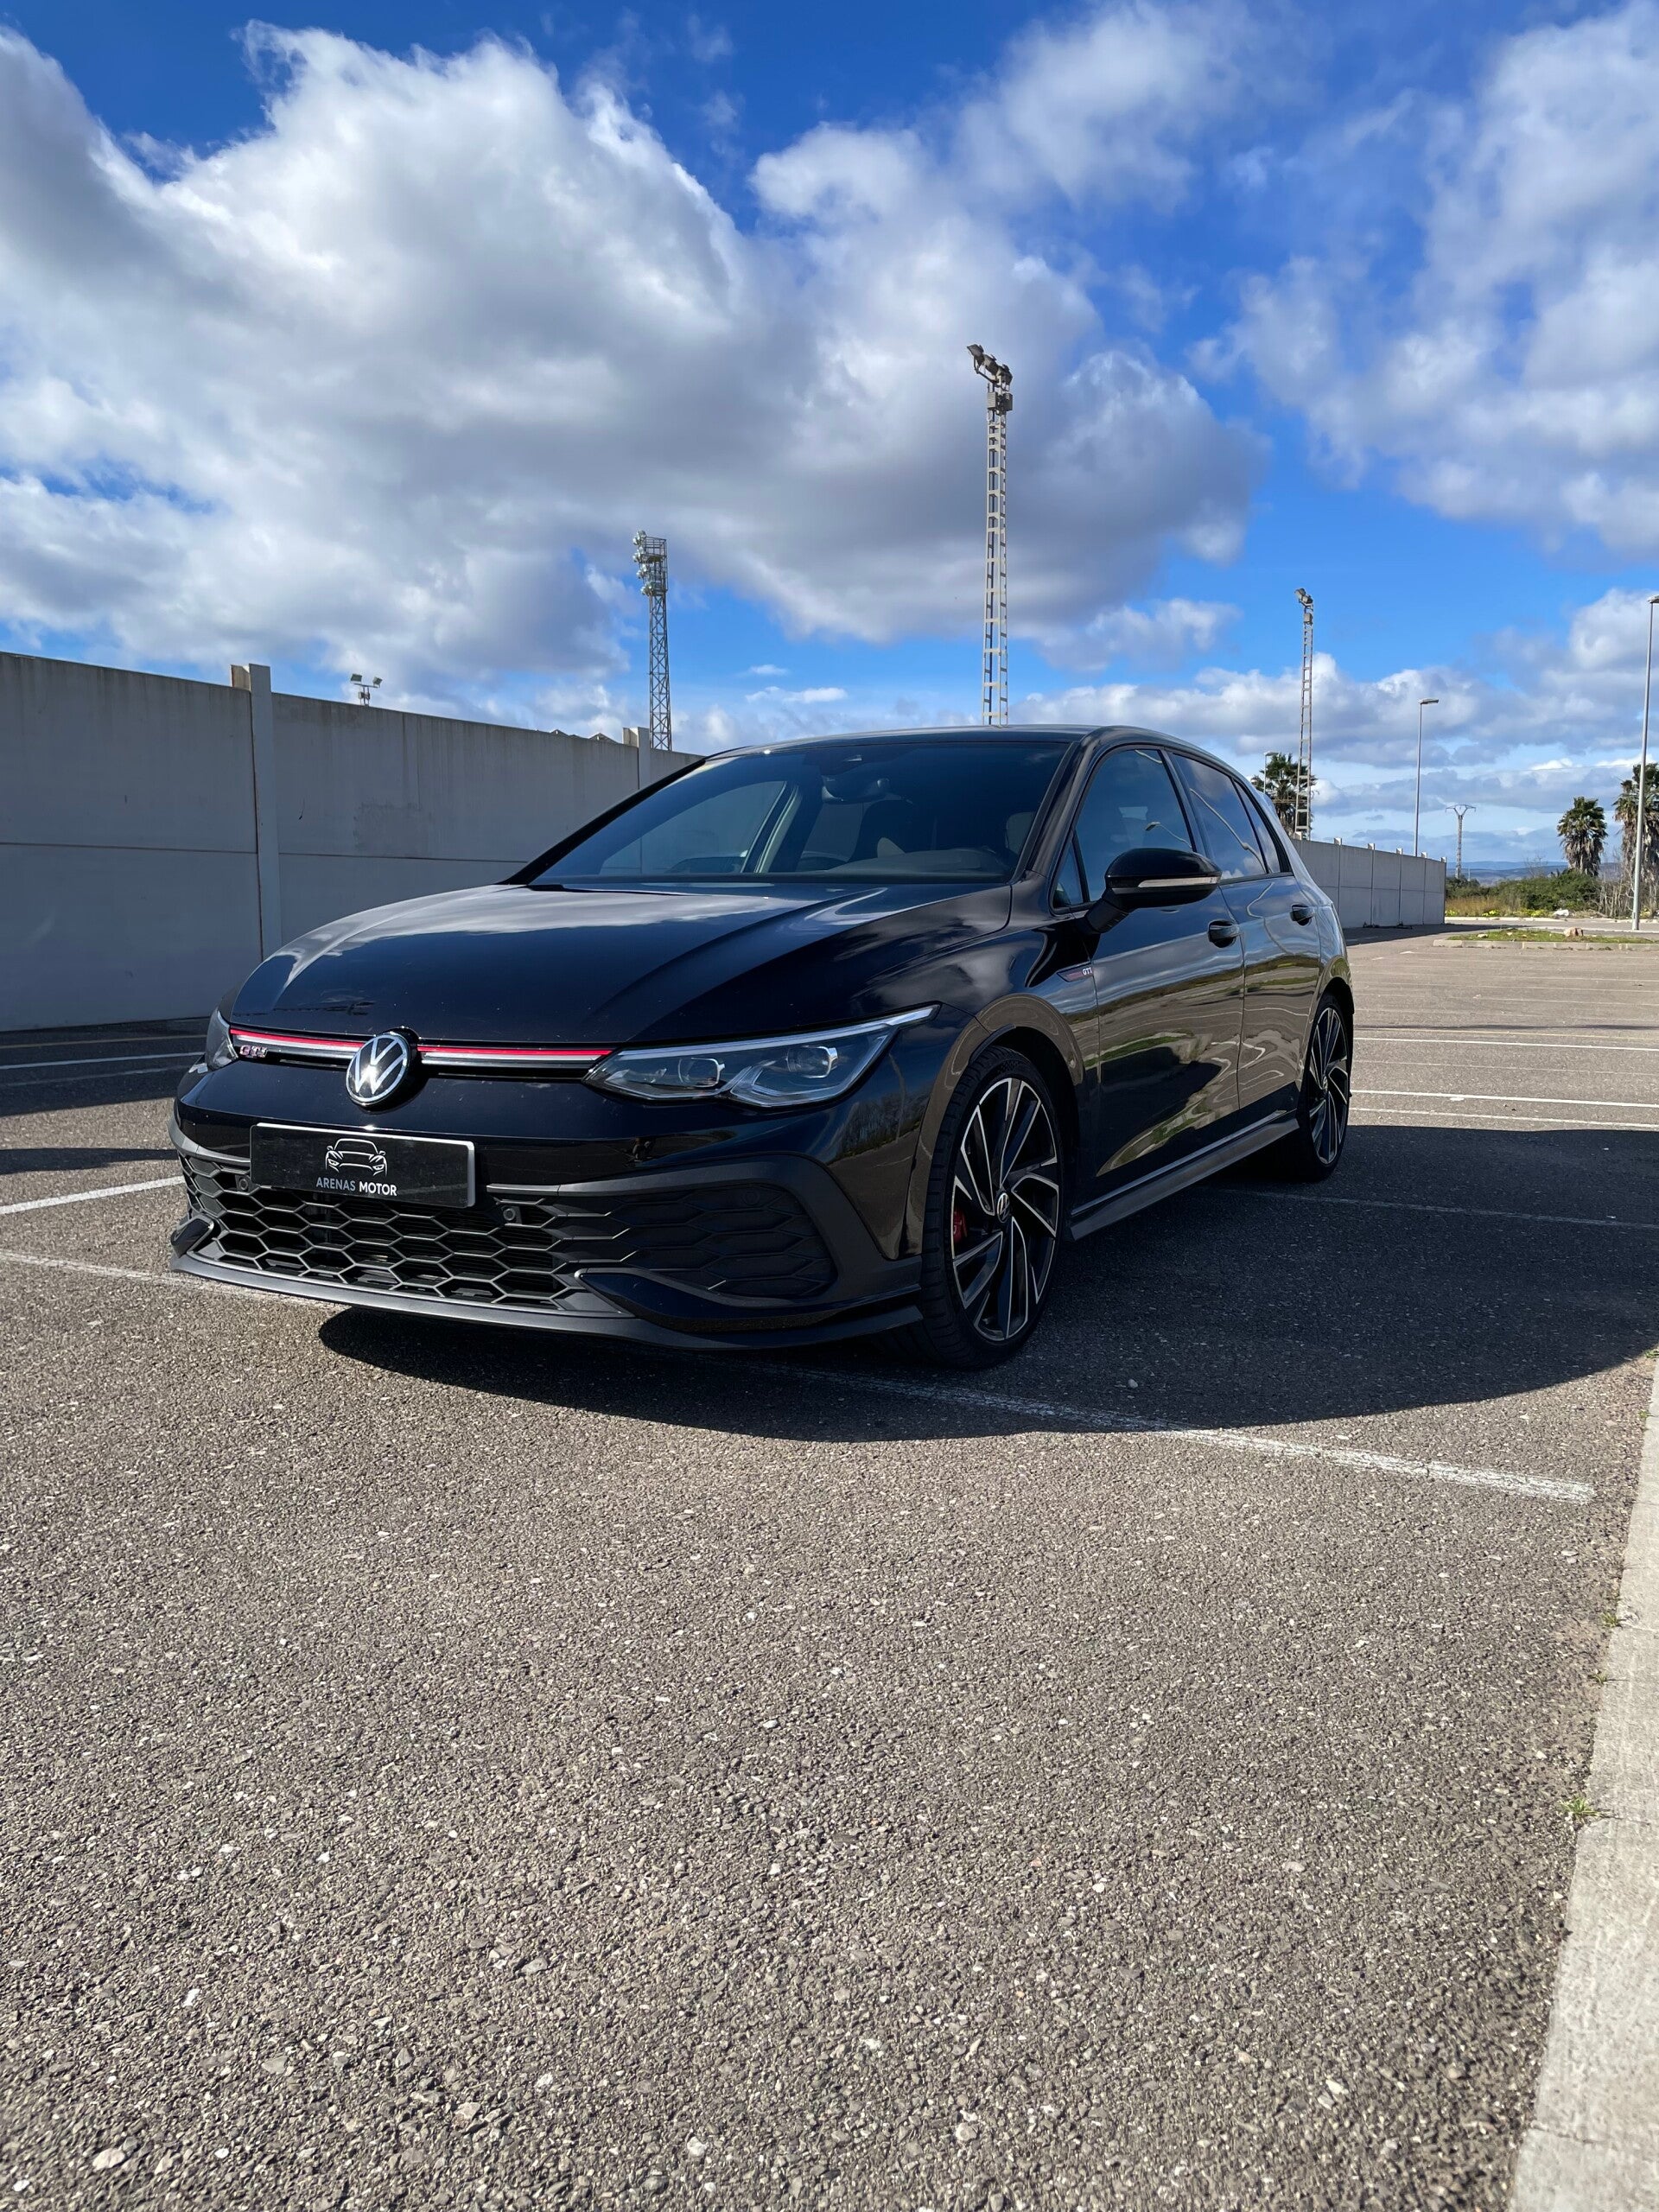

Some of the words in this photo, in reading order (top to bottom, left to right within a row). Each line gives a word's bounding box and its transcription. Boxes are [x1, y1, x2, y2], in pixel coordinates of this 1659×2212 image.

[1082, 967, 1093, 976] GTI
[239, 1045, 269, 1058] GTI
[315, 1176, 356, 1192] ARENAS
[359, 1180, 397, 1197] MOTOR
